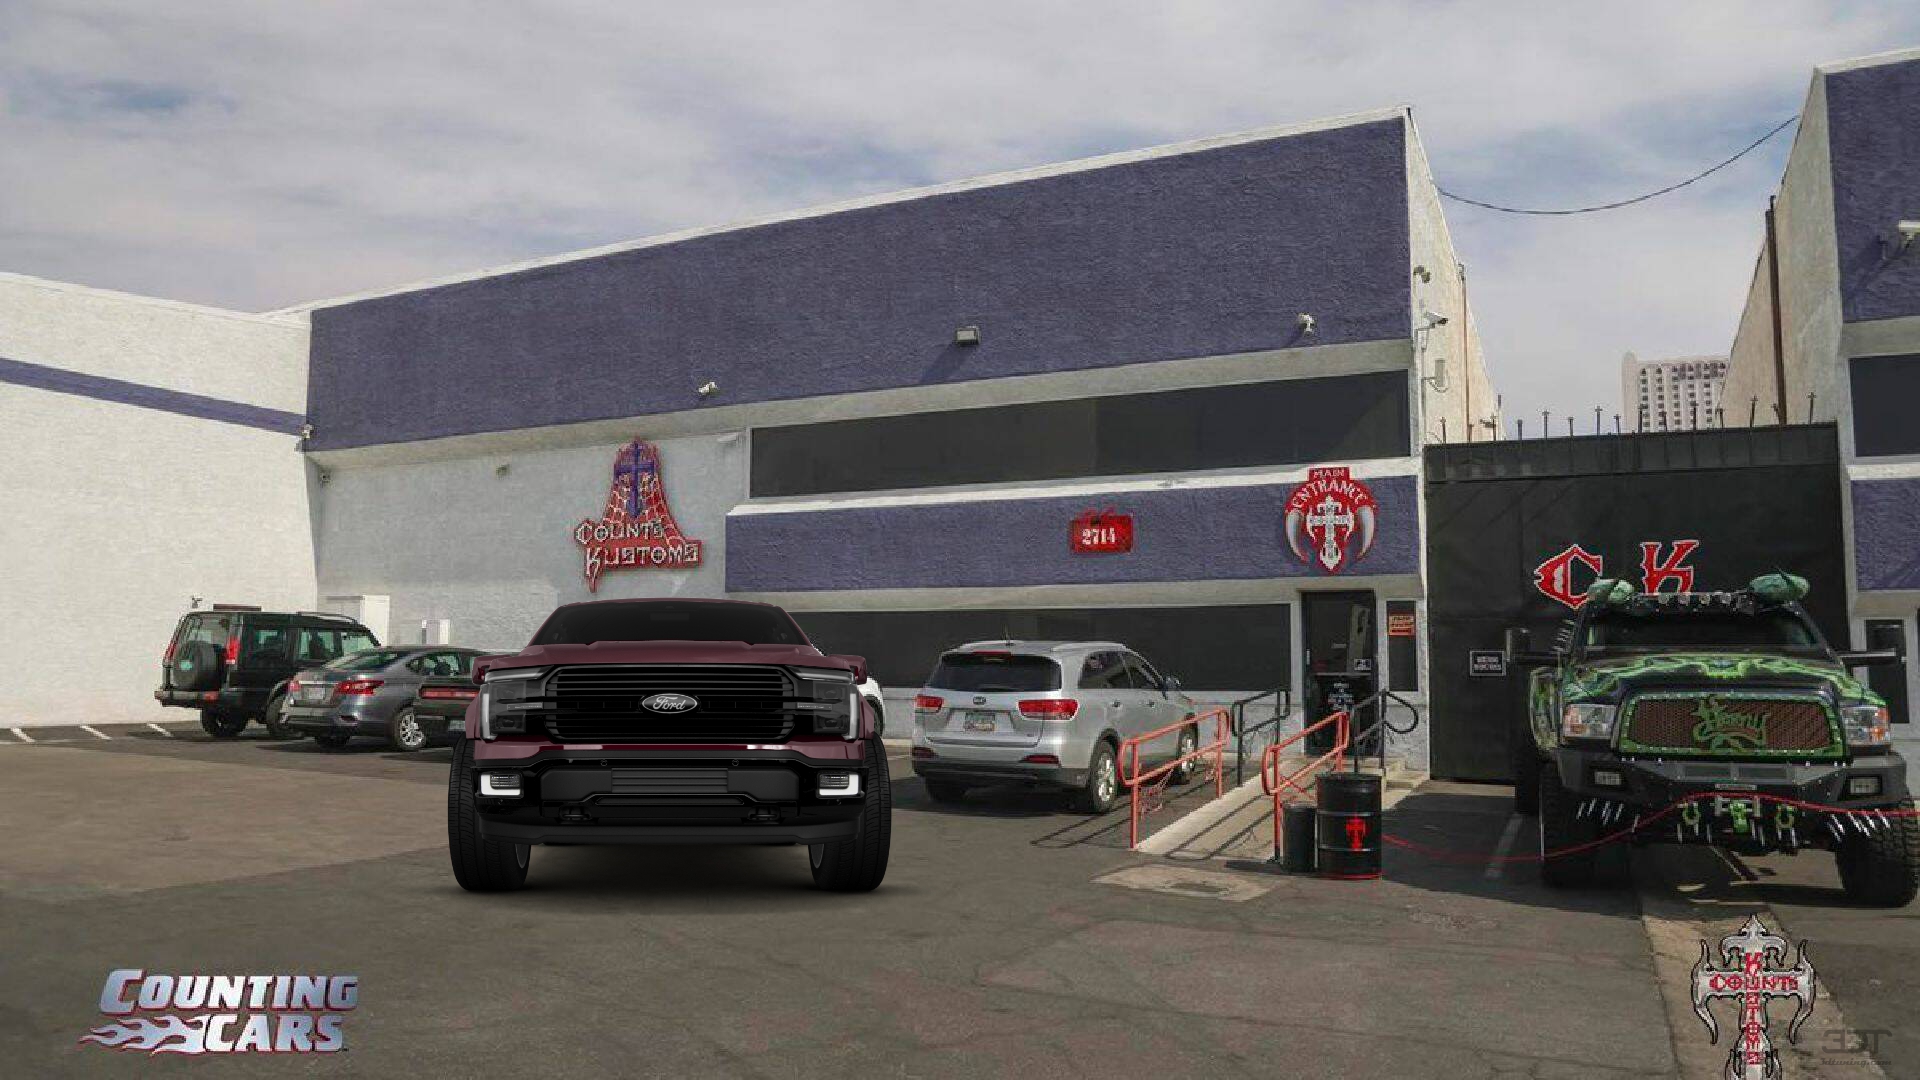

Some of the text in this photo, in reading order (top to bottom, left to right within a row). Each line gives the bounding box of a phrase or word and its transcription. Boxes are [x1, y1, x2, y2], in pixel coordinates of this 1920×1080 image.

[1313, 469, 1344, 479] MAIN
[1293, 480, 1368, 508] ENTRANCE
[1082, 527, 1116, 545] 2714
[585, 543, 699, 593] KUSTOMS
[1533, 539, 1700, 610] C K
[652, 695, 687, 710] Ford
